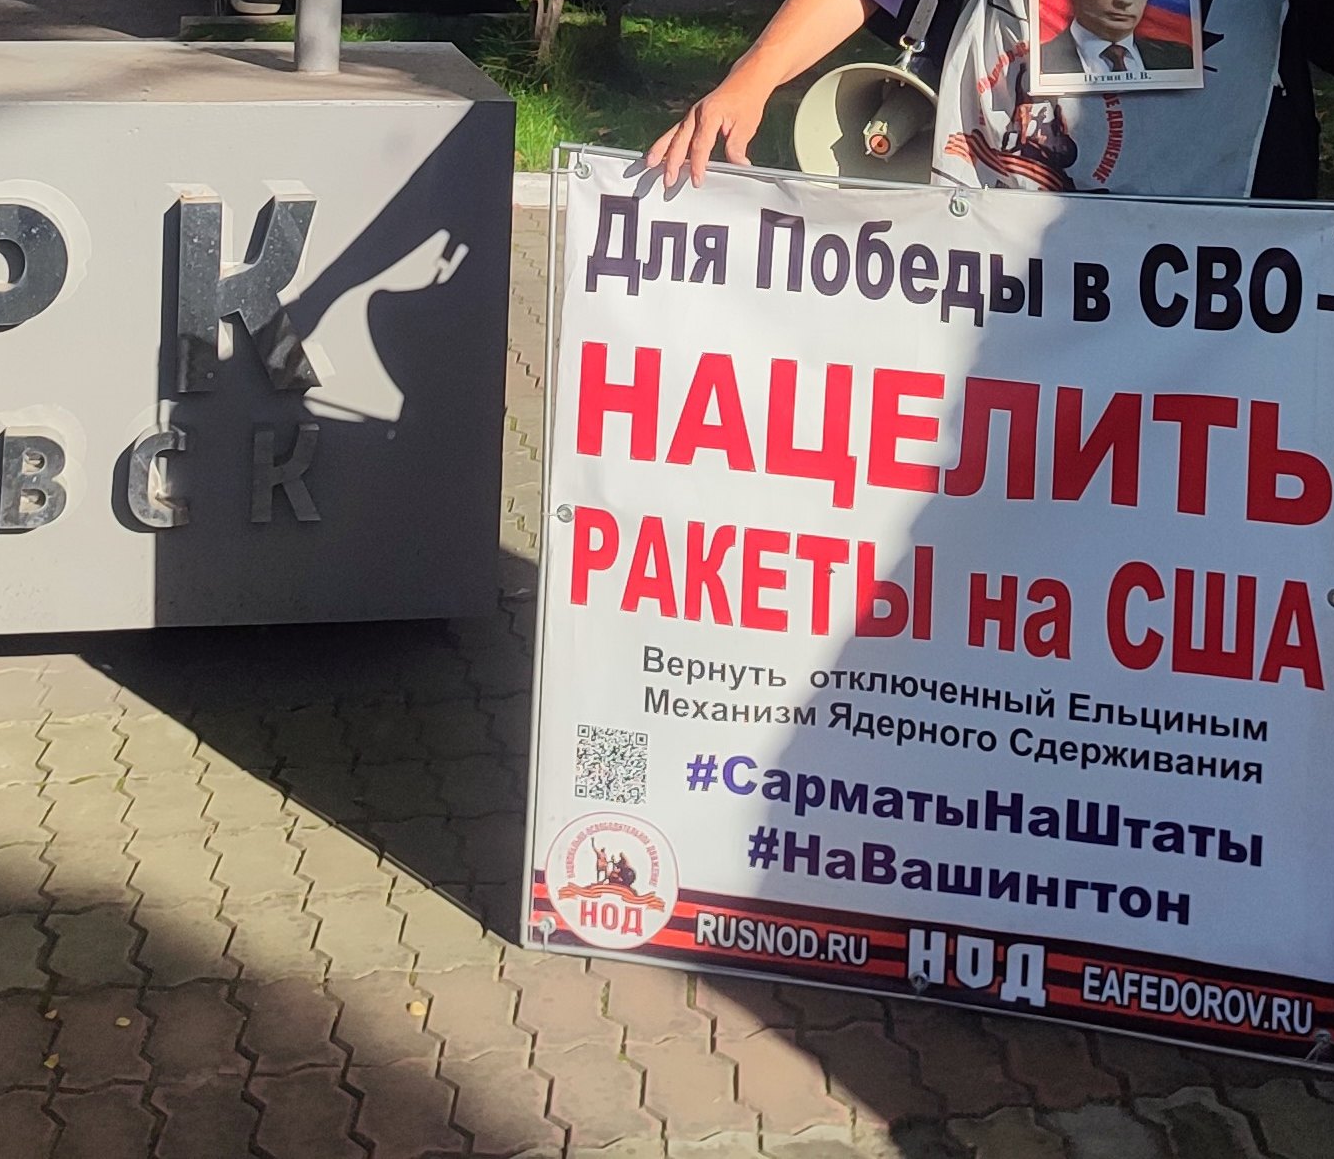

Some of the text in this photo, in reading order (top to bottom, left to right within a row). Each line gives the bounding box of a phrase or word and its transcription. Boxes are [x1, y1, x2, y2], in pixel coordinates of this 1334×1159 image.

[584, 192, 731, 297] Для
[756, 206, 1045, 328] Победы
[1072, 261, 1112, 324] в
[575, 340, 1334, 527] НАЦЕЛИТЬ
[568, 504, 1327, 691] РАКЕТЫ на США
[642, 645, 1269, 742] Вернуть отключенный Ельциным
[643, 686, 1264, 785] Механизм Ядерного Сдерживания
[685, 752, 1265, 867] #СарматыНаШтаты
[579, 899, 644, 937] НОД
[747, 824, 1192, 927] #НаВашингтон
[695, 911, 869, 967] RUSNOD.RU
[906, 928, 1049, 1010] НОД
[1082, 965, 1314, 1037] EAFEDOROV.RU
